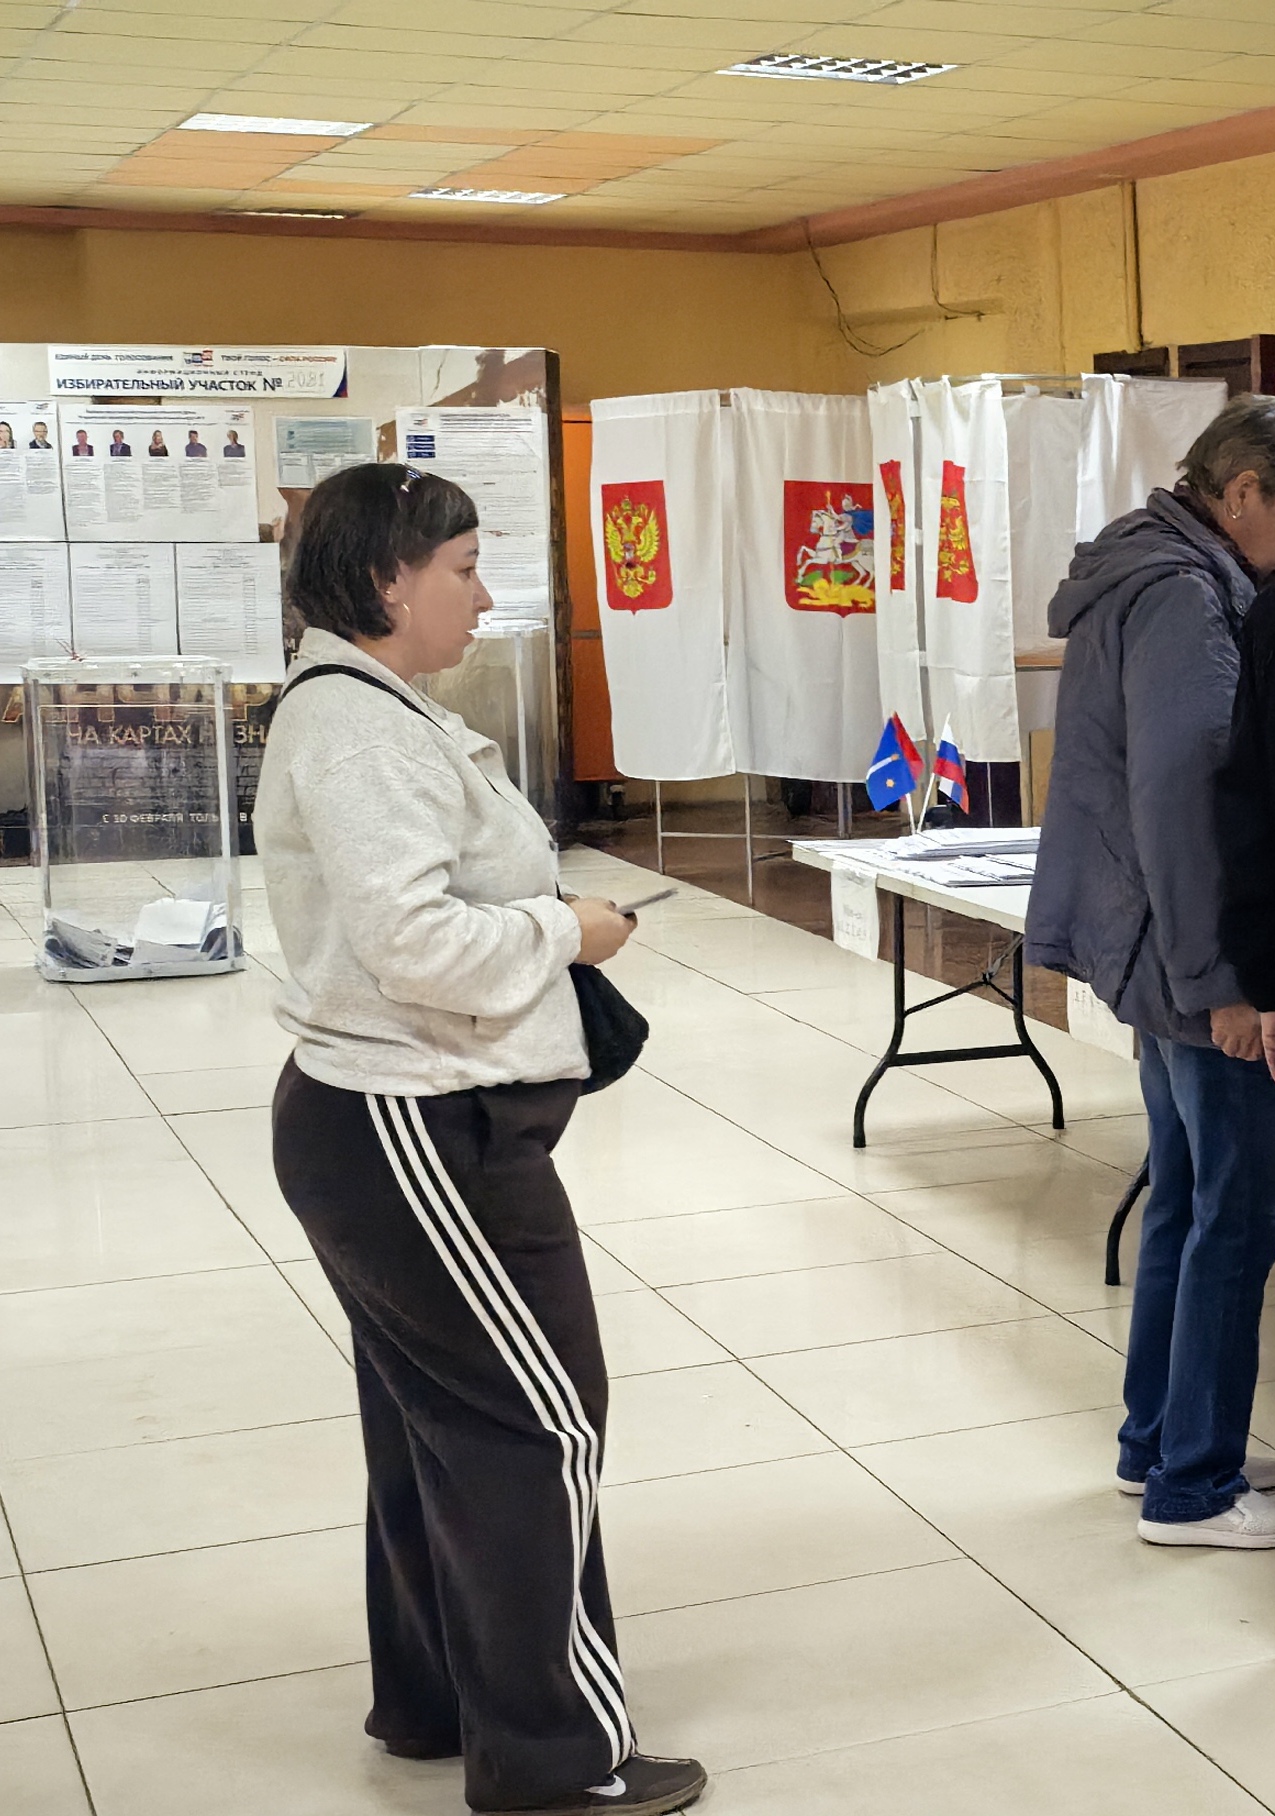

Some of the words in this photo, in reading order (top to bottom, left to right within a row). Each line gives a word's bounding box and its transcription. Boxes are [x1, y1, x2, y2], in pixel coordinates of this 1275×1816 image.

[56, 377, 185, 391] ИЗБИРАТЕЛЬНЫЙ
[187, 380, 257, 391] УЧАСТОК
[262, 377, 283, 391] №
[109, 725, 192, 745] КАРТАХ
